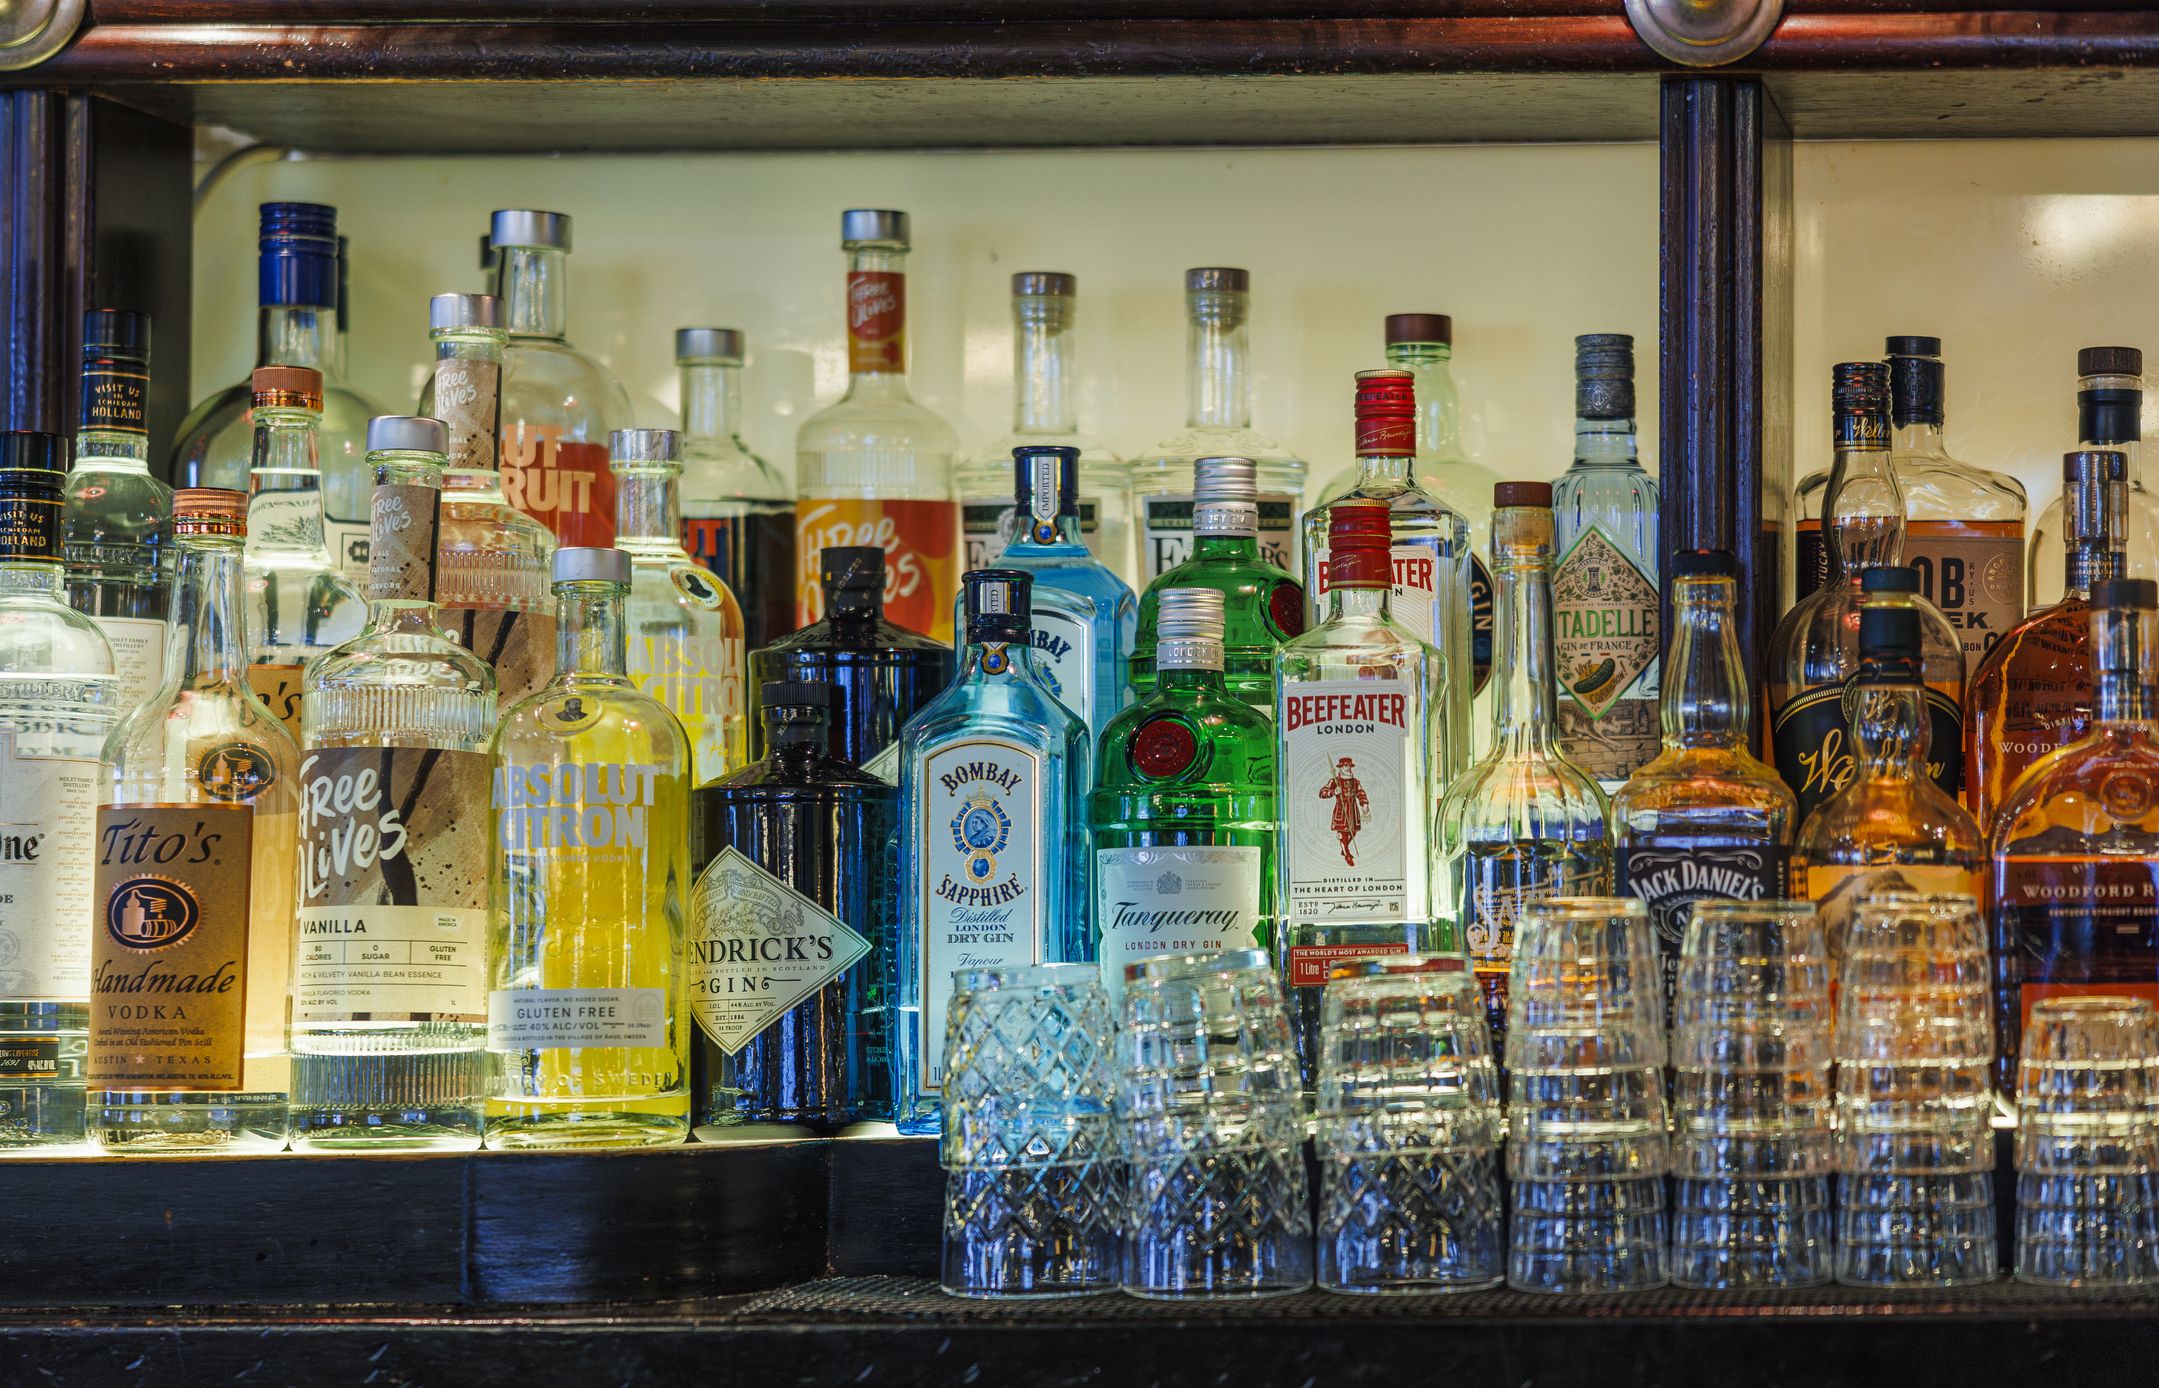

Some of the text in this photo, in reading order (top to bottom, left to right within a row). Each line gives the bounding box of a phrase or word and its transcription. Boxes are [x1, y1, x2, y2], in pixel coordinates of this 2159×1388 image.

[95, 384, 139, 397] VISIT US
[92, 407, 141, 419] HOLLAND
[1042, 463, 1050, 511] IMPORTED
[30, 513, 44, 523] US
[0, 535, 47, 547] OLLAND
[1561, 642, 1578, 651] GIN
[1590, 641, 1632, 650] FRANCE
[1287, 693, 1406, 733] BEEFEATER
[1317, 724, 1375, 734] LONDON
[491, 762, 660, 809] ABSOLUT
[940, 761, 1023, 797] BOMBAY
[500, 805, 643, 849] CITRON
[102, 818, 222, 865] Tito's
[1628, 866, 1678, 902] JACK
[1681, 860, 1765, 901] DANIEL'S
[936, 873, 1024, 907] SAPPHIRE
[2023, 884, 2135, 899] WOODFORD
[949, 906, 1013, 924] Distilled
[1111, 901, 1240, 933] Tanqueray
[303, 919, 367, 935] VANILLA
[956, 924, 1007, 932] LONDON
[946, 933, 1014, 944] DRY GIN
[430, 945, 457, 953] GLUTEN
[1126, 940, 1222, 951] LONDON DRY GIN
[1310, 949, 1337, 957] WORLD'S
[958, 952, 1004, 968] Vapour
[318, 971, 345, 979] VELVETY
[348, 970, 380, 978] VANILLA
[383, 970, 405, 978] BEAN
[408, 970, 443, 979] ESSENCE
[773, 965, 827, 973] SCOTLAND
[1305, 962, 1319, 975] Litre
[91, 959, 237, 994] Handmade
[710, 976, 757, 994] GIN
[108, 1005, 187, 1020] VODKA
[517, 1006, 616, 1019] GLUTEN FREE
[181, 1027, 205, 1036] Vodka
[530, 1022, 550, 1031] 40%
[552, 1021, 600, 1031] ALC/VOL
[94, 1055, 212, 1065] AUSTIN TEXAS
[594, 1072, 672, 1087] SWEDEN
